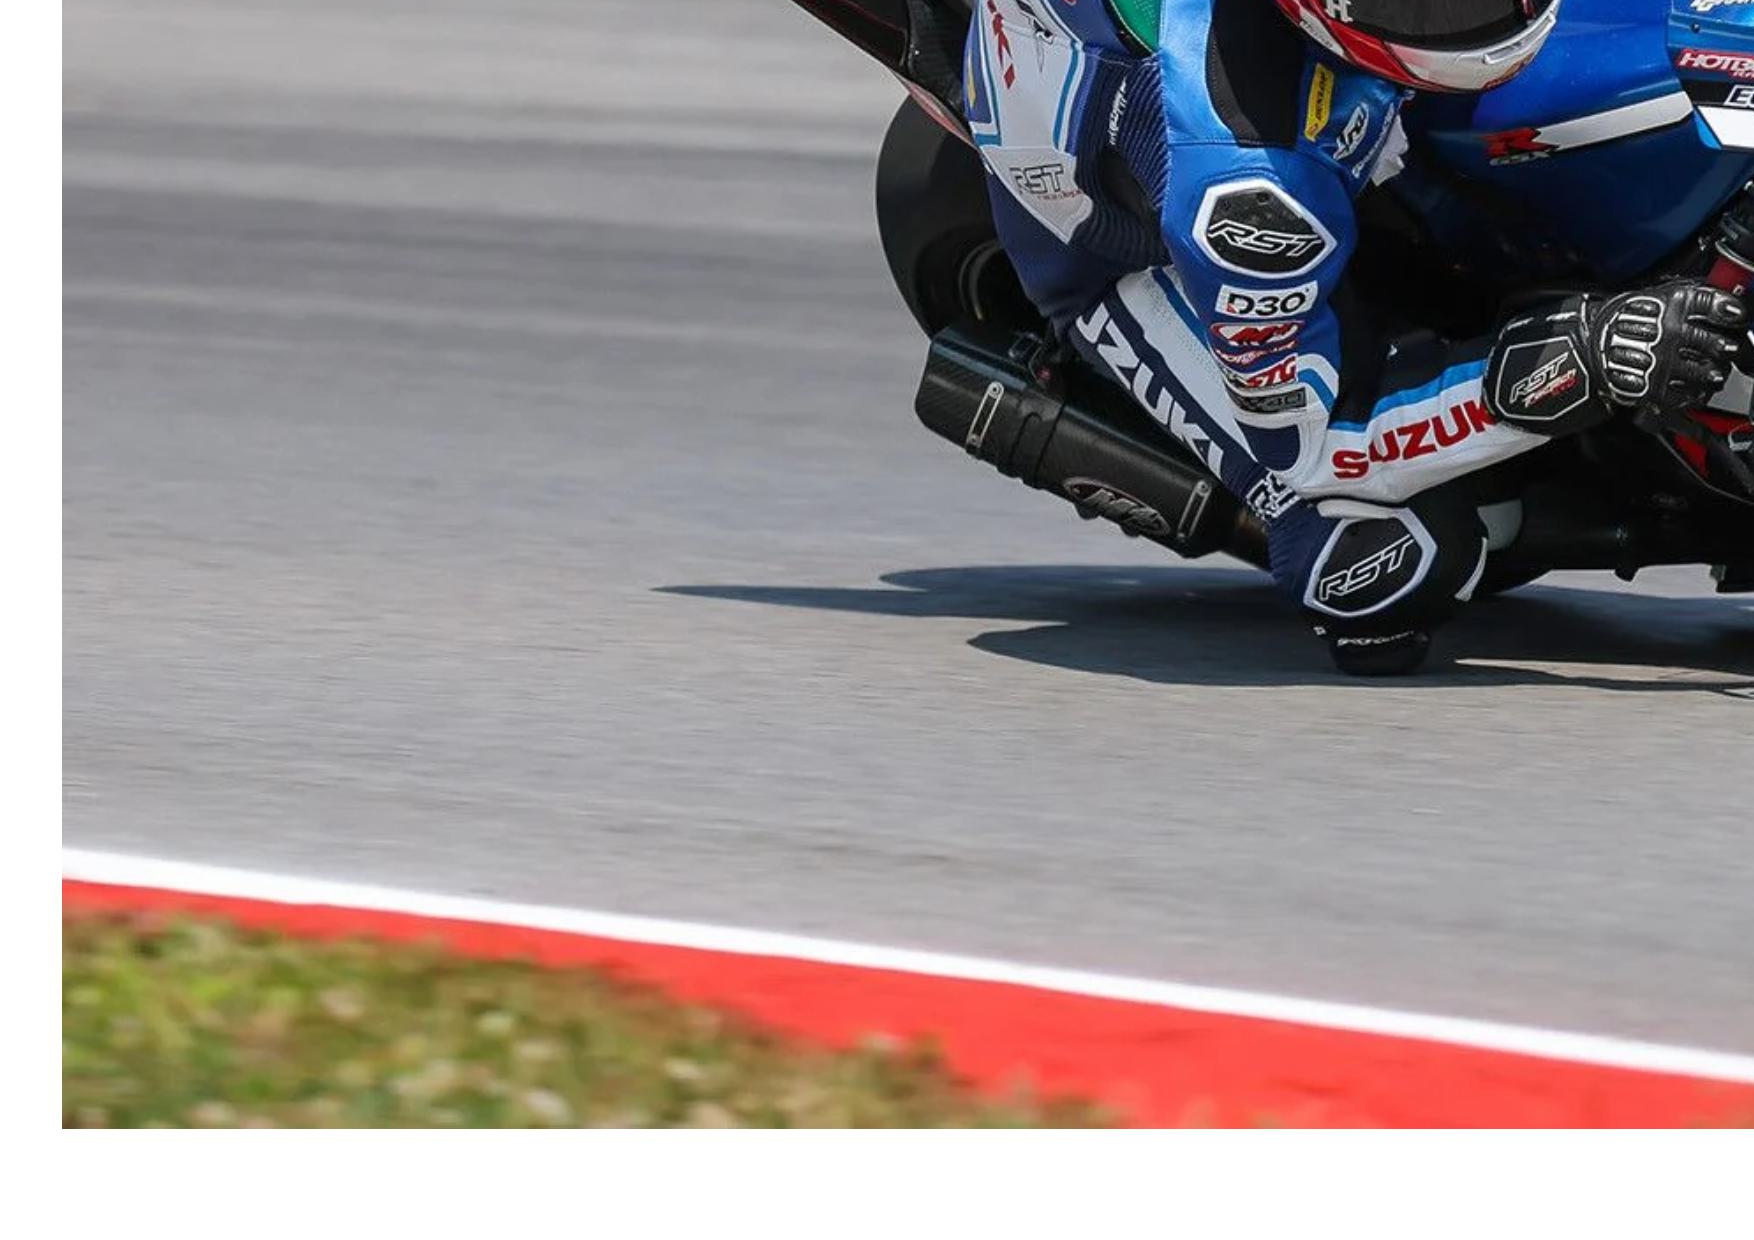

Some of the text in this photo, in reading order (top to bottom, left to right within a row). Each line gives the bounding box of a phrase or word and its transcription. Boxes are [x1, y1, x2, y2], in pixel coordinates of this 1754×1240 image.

[1208, 219, 1325, 258] RST
[1075, 301, 1223, 476] UZUKI
[1508, 351, 1570, 405] RST
[1332, 398, 1496, 481] SUZUK
[1318, 533, 1414, 602] RST
